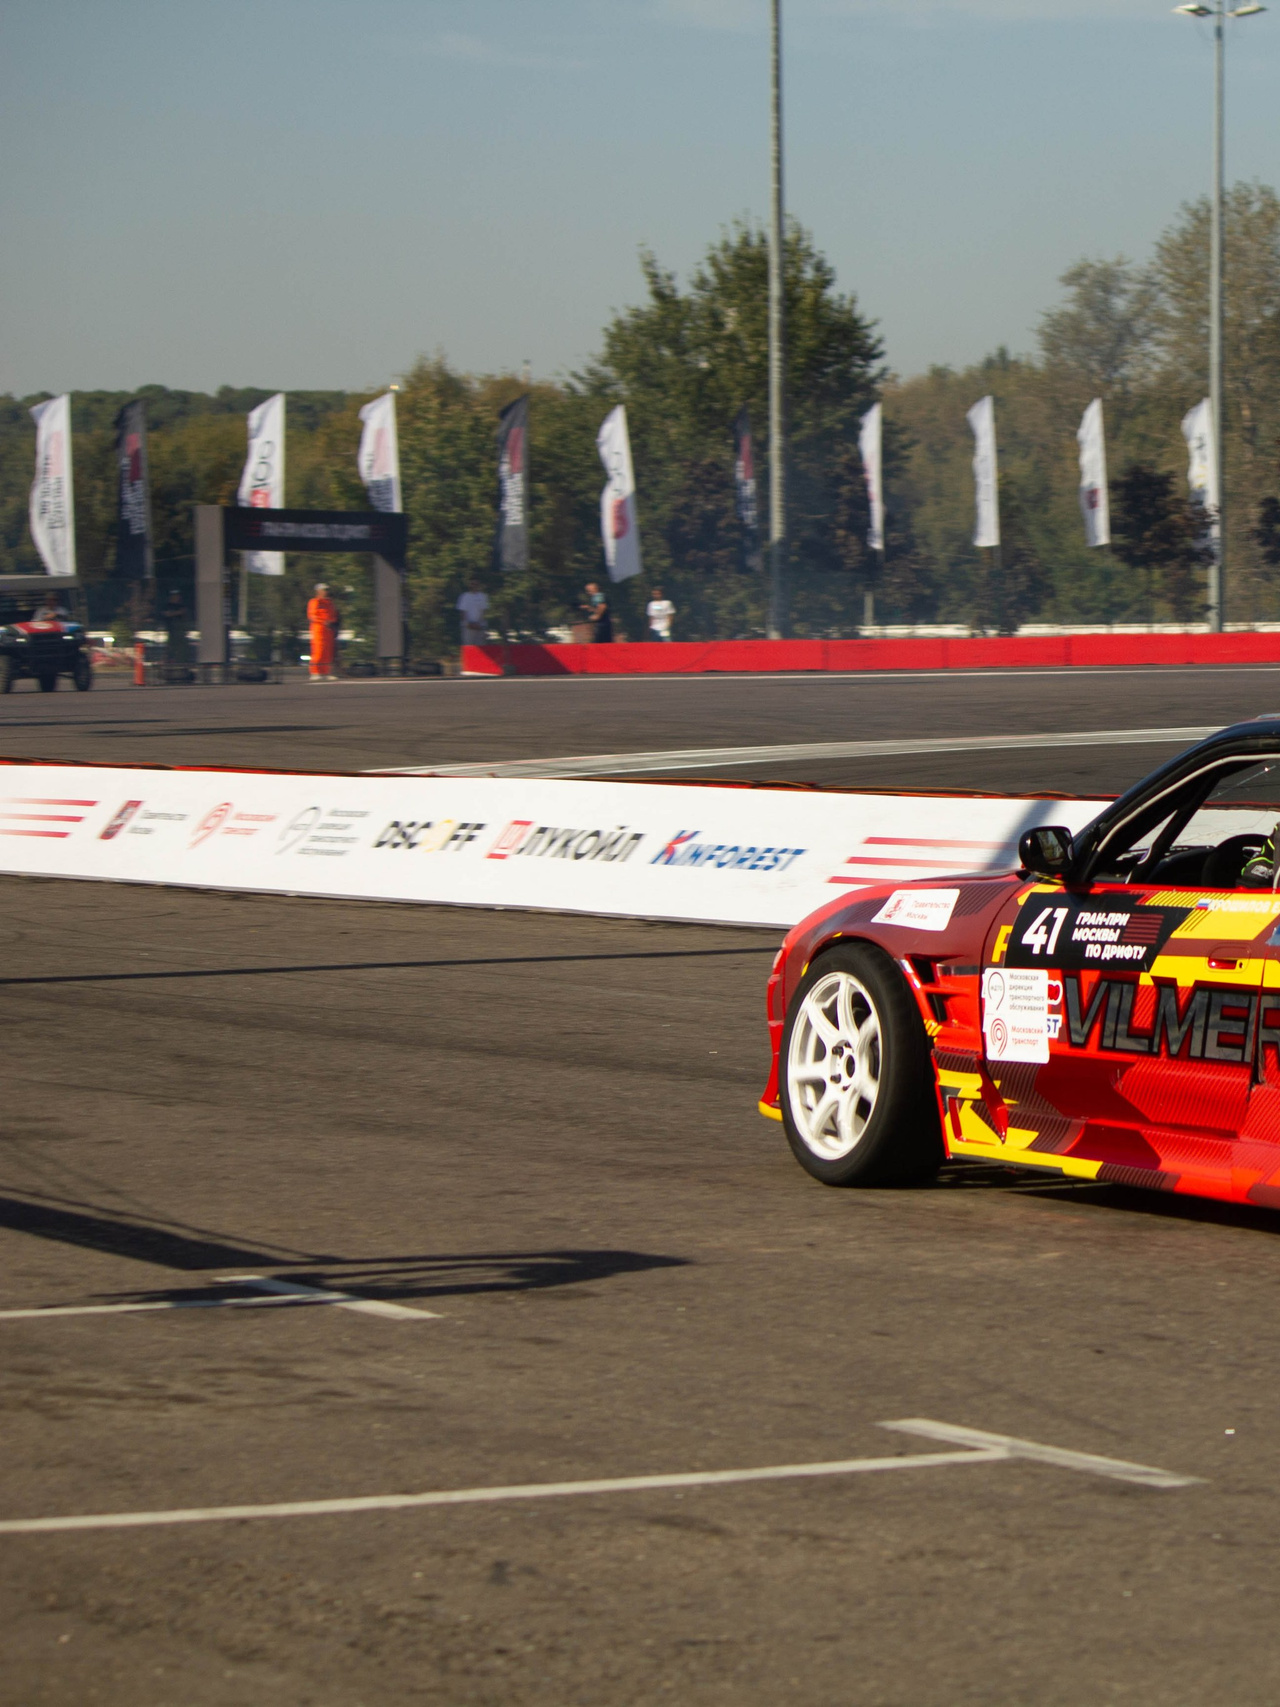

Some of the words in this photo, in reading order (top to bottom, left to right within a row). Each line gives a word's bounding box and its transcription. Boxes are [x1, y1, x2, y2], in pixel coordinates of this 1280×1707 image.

[1075, 911, 1130, 927] ГРАН-ПРИ
[1021, 907, 1069, 955] 41
[1072, 927, 1120, 942] МОСКВЫ
[1085, 943, 1101, 958] ПО
[1101, 945, 1147, 960] ДРИФТУ
